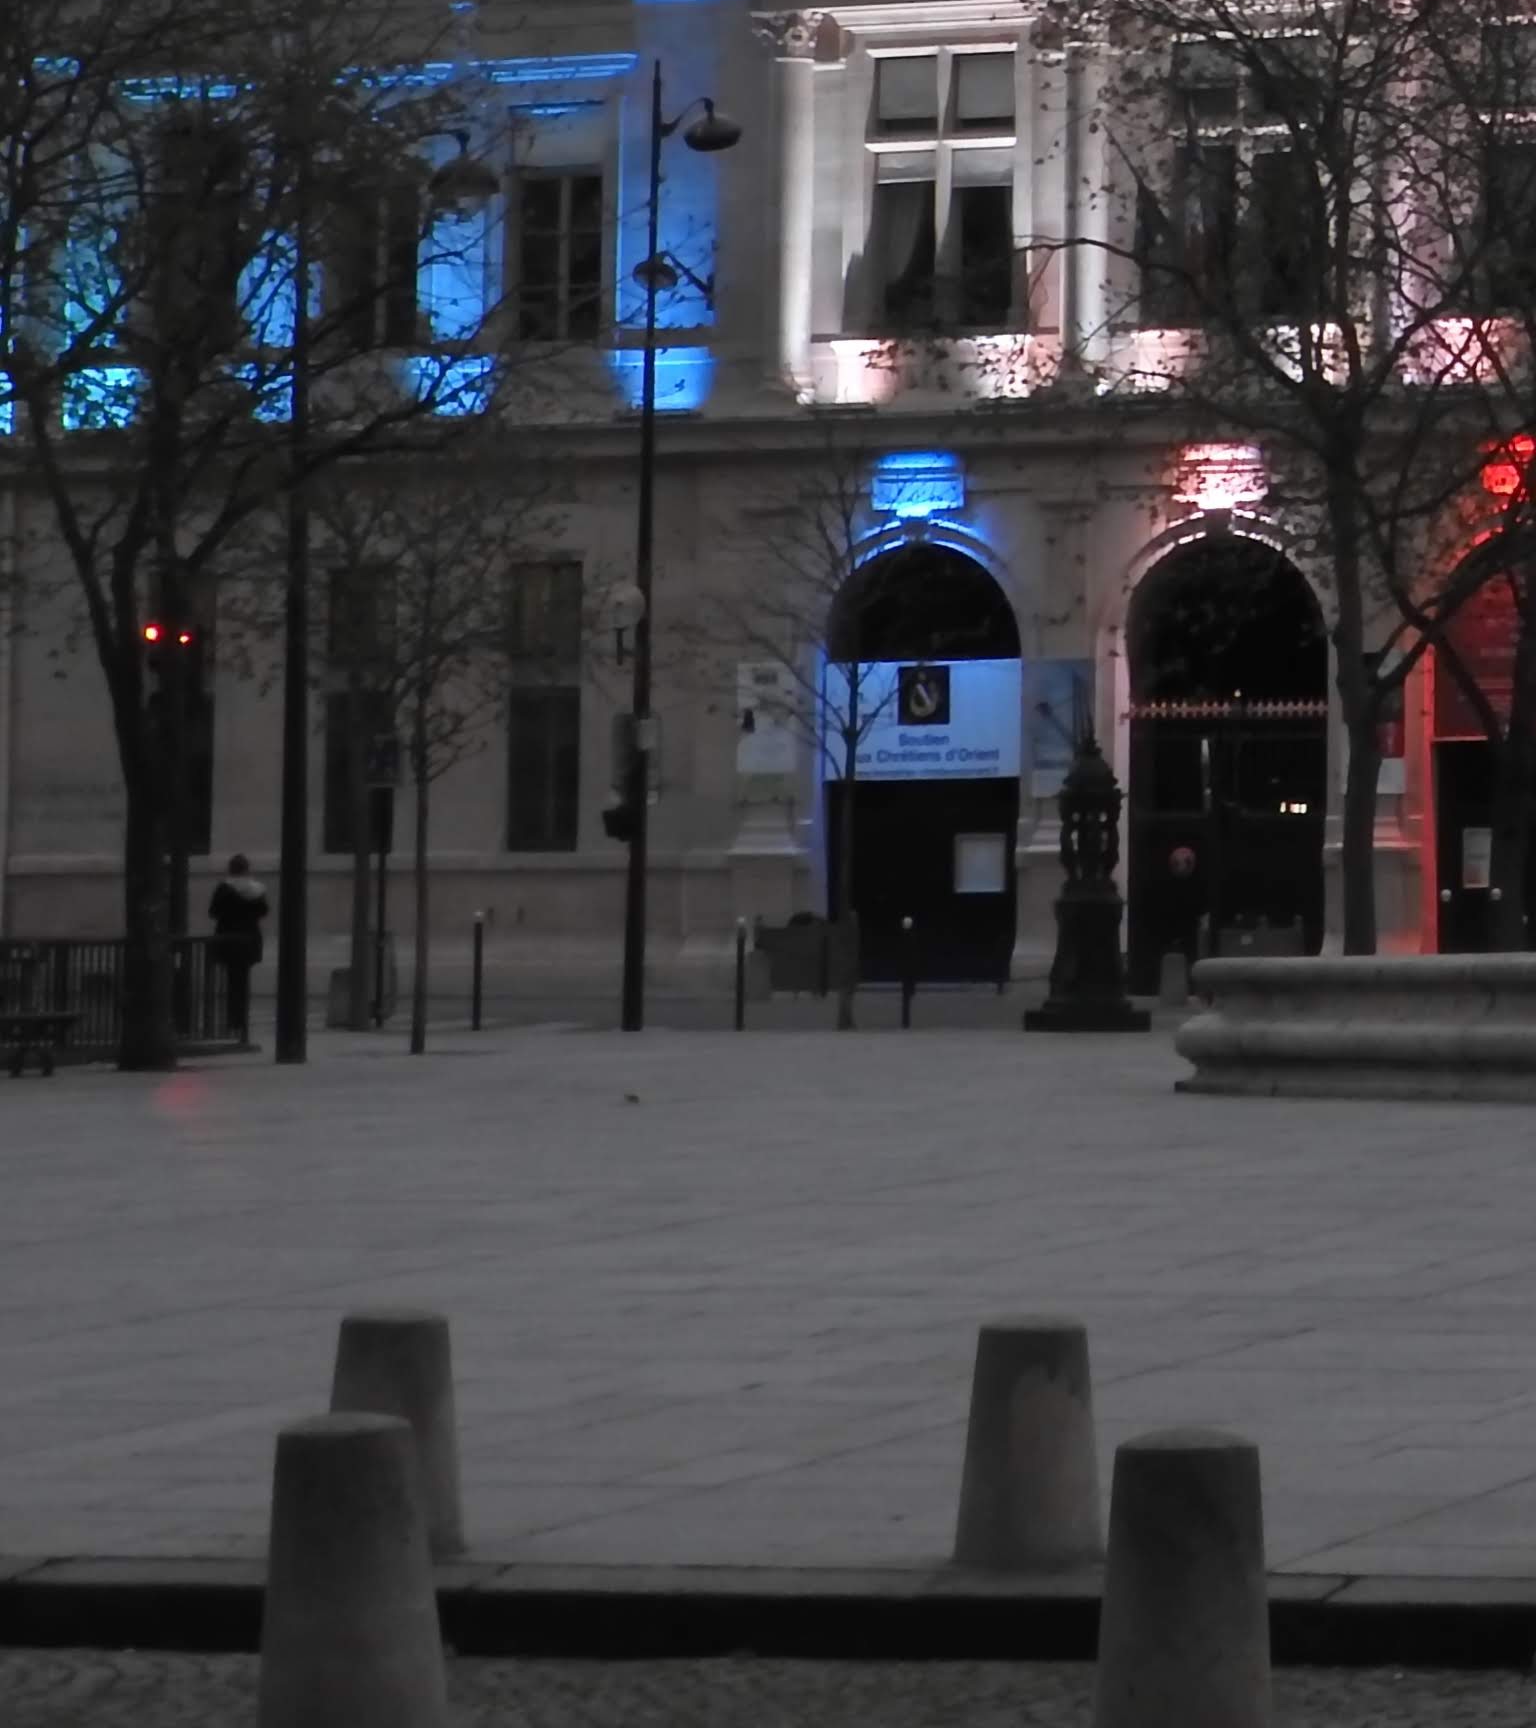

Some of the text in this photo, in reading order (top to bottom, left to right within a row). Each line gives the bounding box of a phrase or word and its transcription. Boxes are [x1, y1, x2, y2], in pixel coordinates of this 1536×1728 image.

[899, 733, 950, 747] Soutien
[876, 749, 941, 763] Chrétiens
[945, 748, 999, 762] d'Orient
